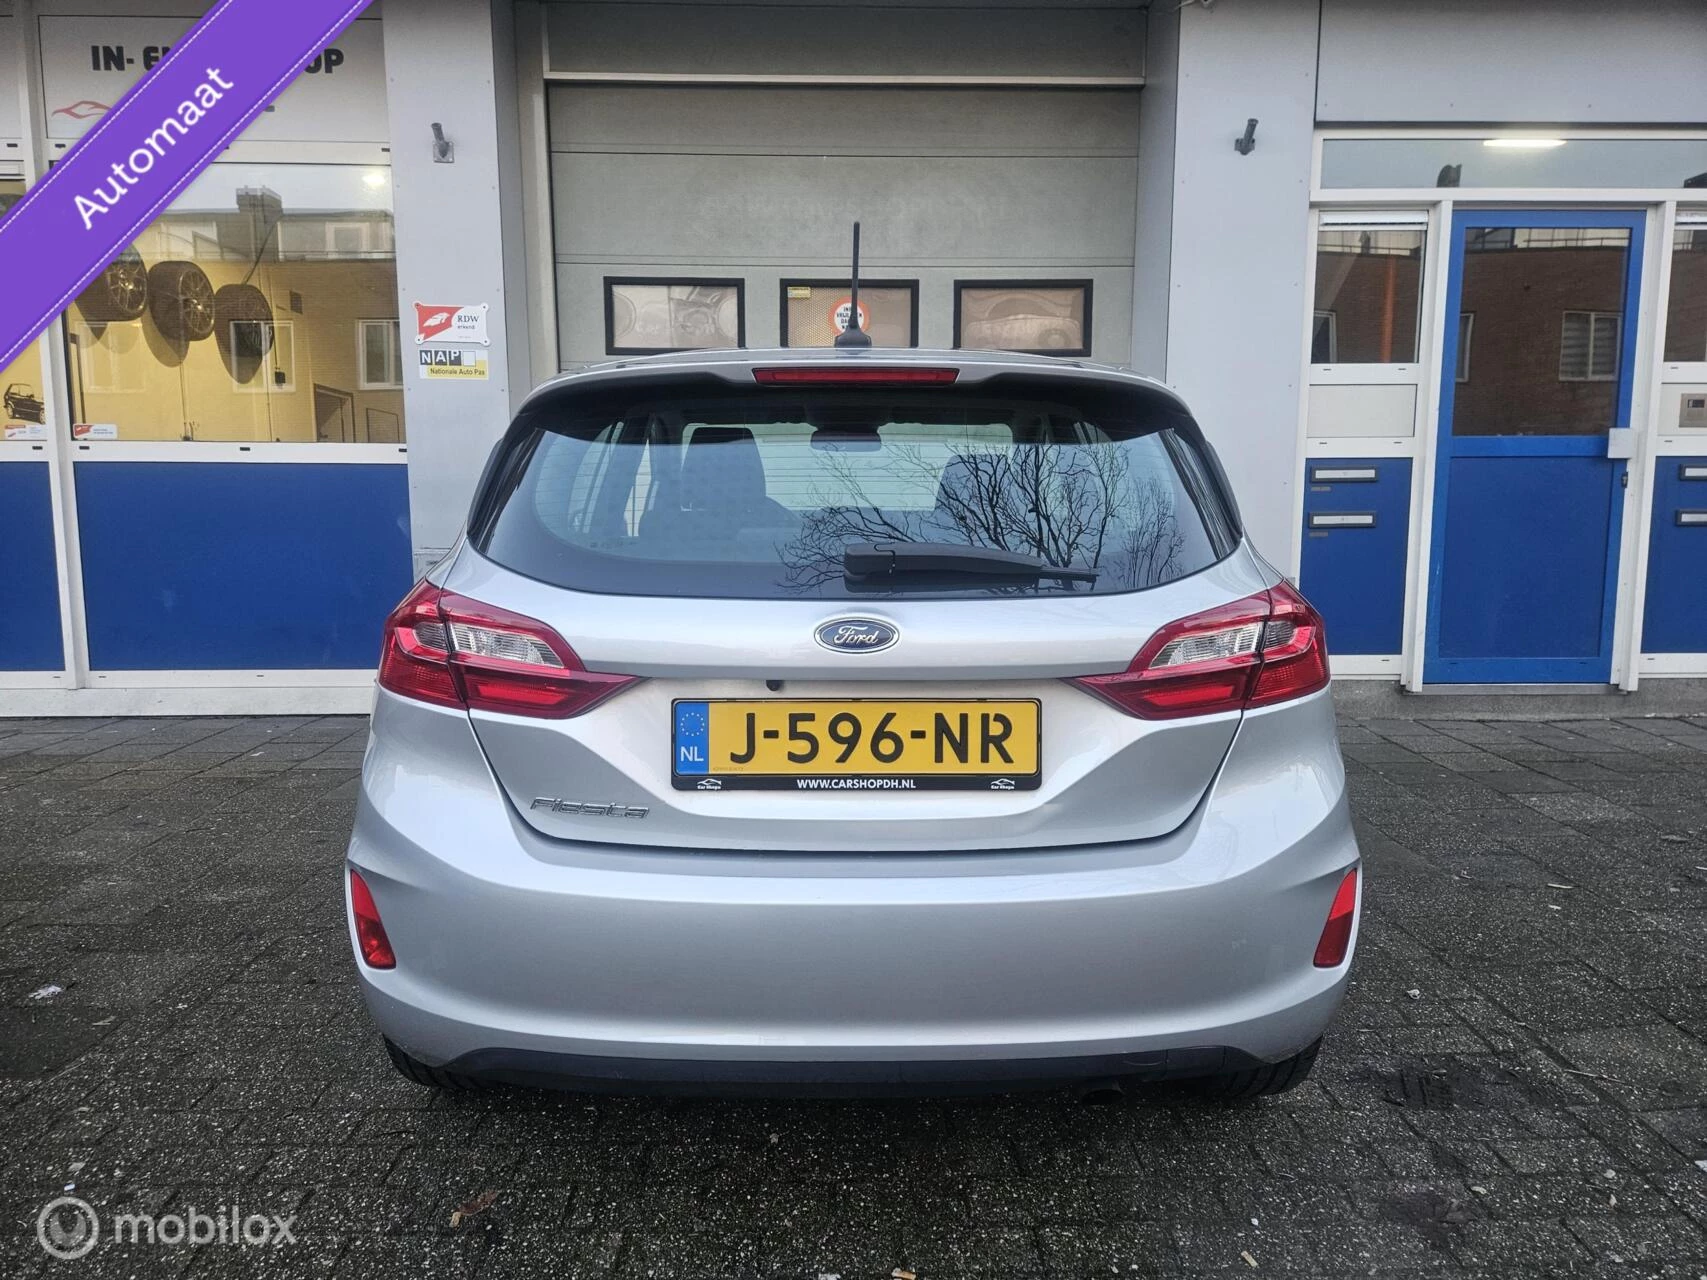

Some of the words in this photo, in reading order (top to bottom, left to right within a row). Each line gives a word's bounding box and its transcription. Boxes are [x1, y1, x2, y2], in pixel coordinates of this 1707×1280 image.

[90, 45, 134, 71] IN-
[457, 315, 480, 323] RDW
[420, 350, 462, 366] NAP
[430, 368, 458, 376] Nationale
[458, 368, 473, 376] Auto
[834, 625, 880, 645] Ford
[730, 712, 1014, 764] J-596-NR
[680, 746, 704, 762] NL
[796, 778, 917, 790] WWW.CARSHOPDH.NL
[530, 796, 650, 819] Fiesta
